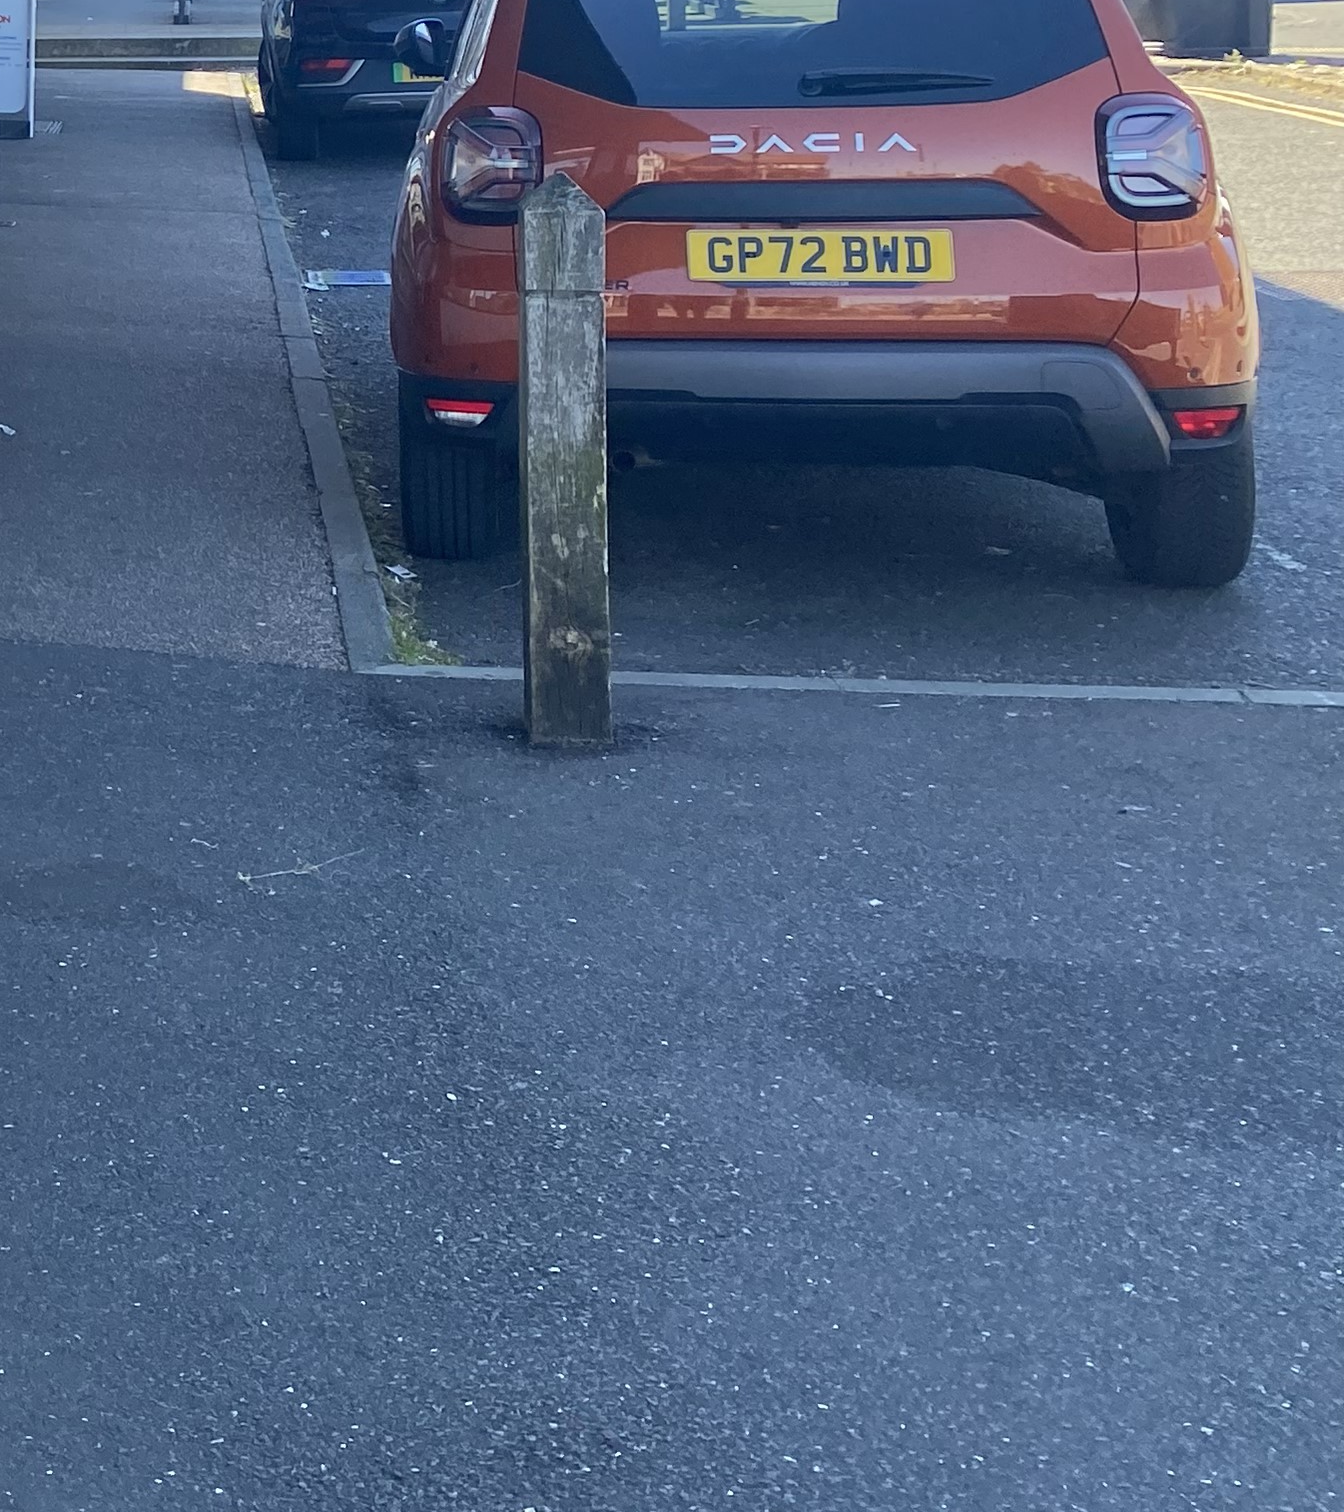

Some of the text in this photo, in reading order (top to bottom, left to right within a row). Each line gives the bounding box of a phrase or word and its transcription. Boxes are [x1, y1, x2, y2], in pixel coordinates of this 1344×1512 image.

[710, 131, 917, 155] DACIA
[708, 236, 932, 274] GP72 BWD
